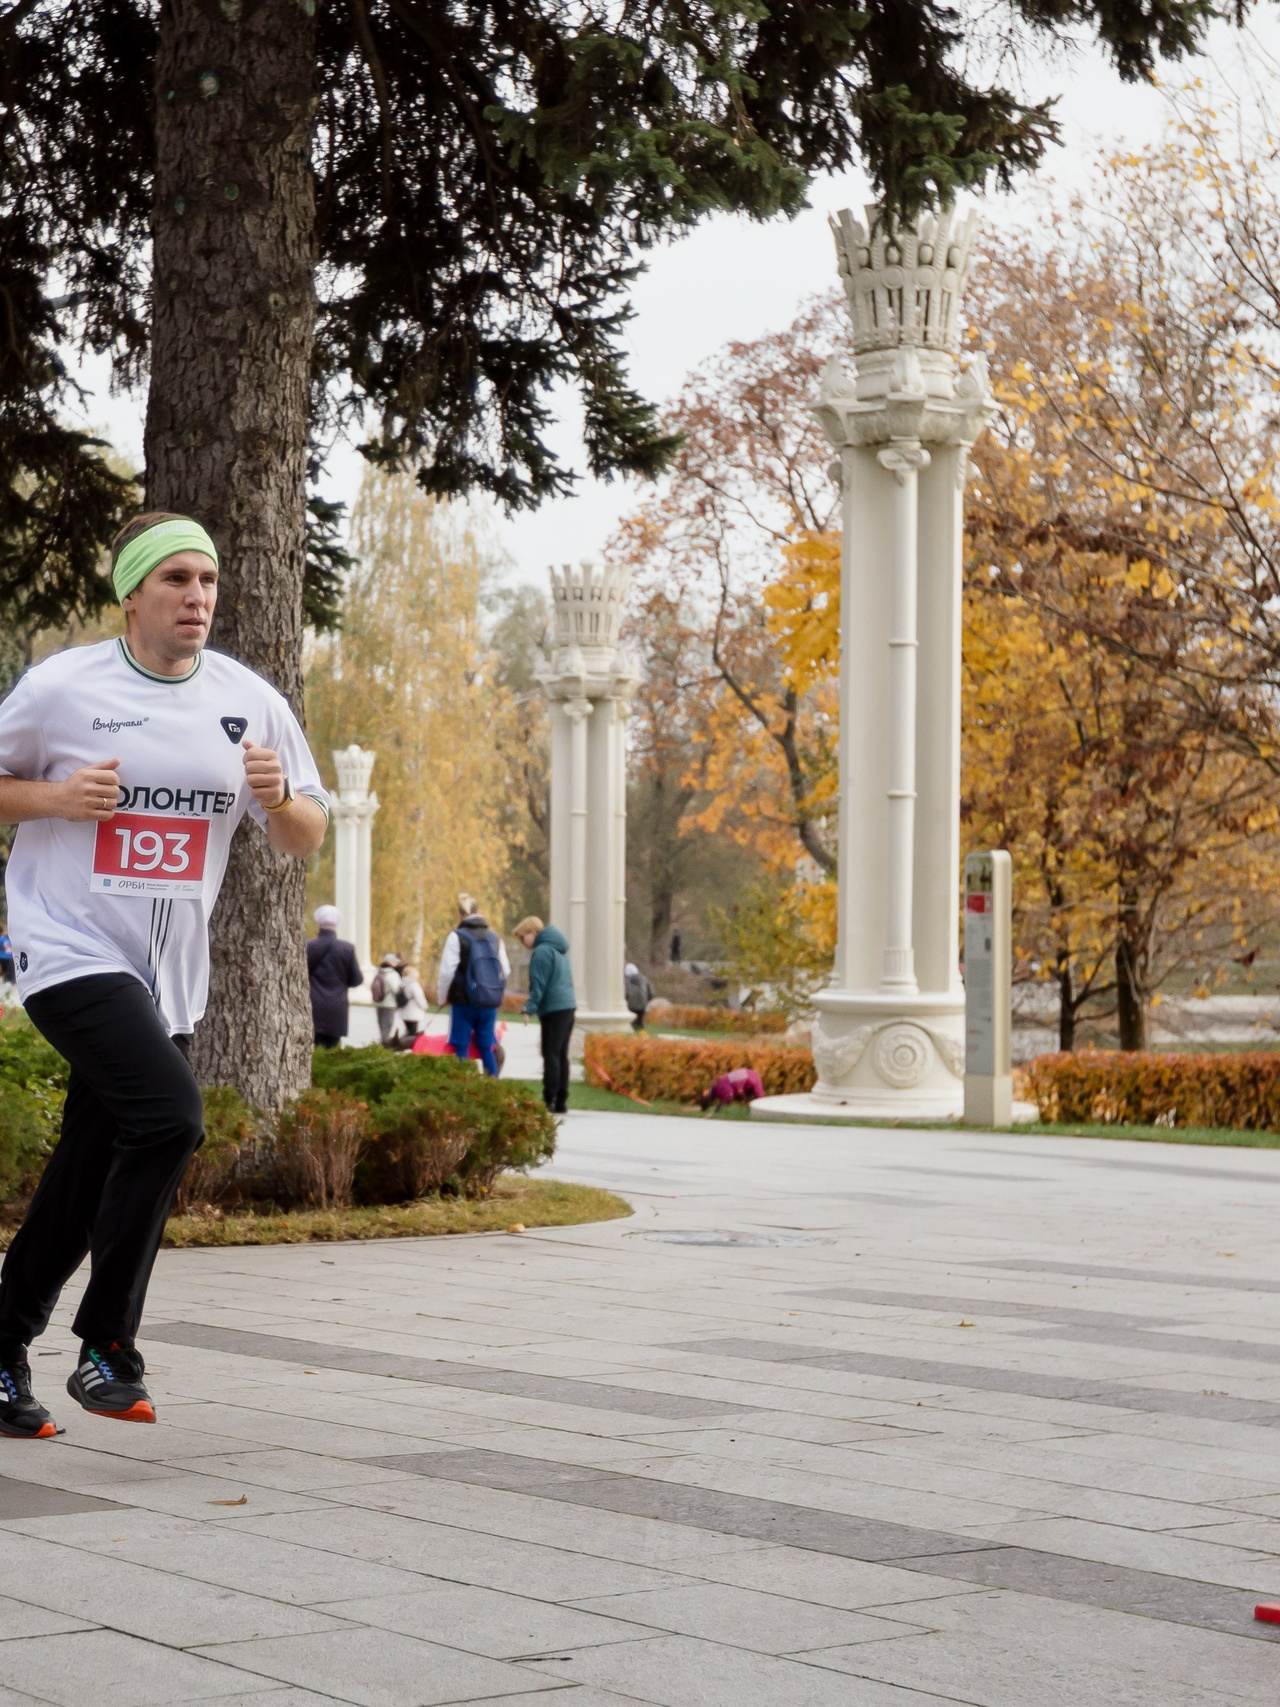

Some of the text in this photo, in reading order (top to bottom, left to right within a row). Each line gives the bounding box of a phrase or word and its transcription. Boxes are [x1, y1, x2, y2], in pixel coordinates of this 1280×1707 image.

[92, 717, 143, 733] Выручаем
[116, 785, 236, 814] ОЛОНТЕР
[115, 828, 191, 873] 193
[118, 880, 145, 890] ОРБИ
